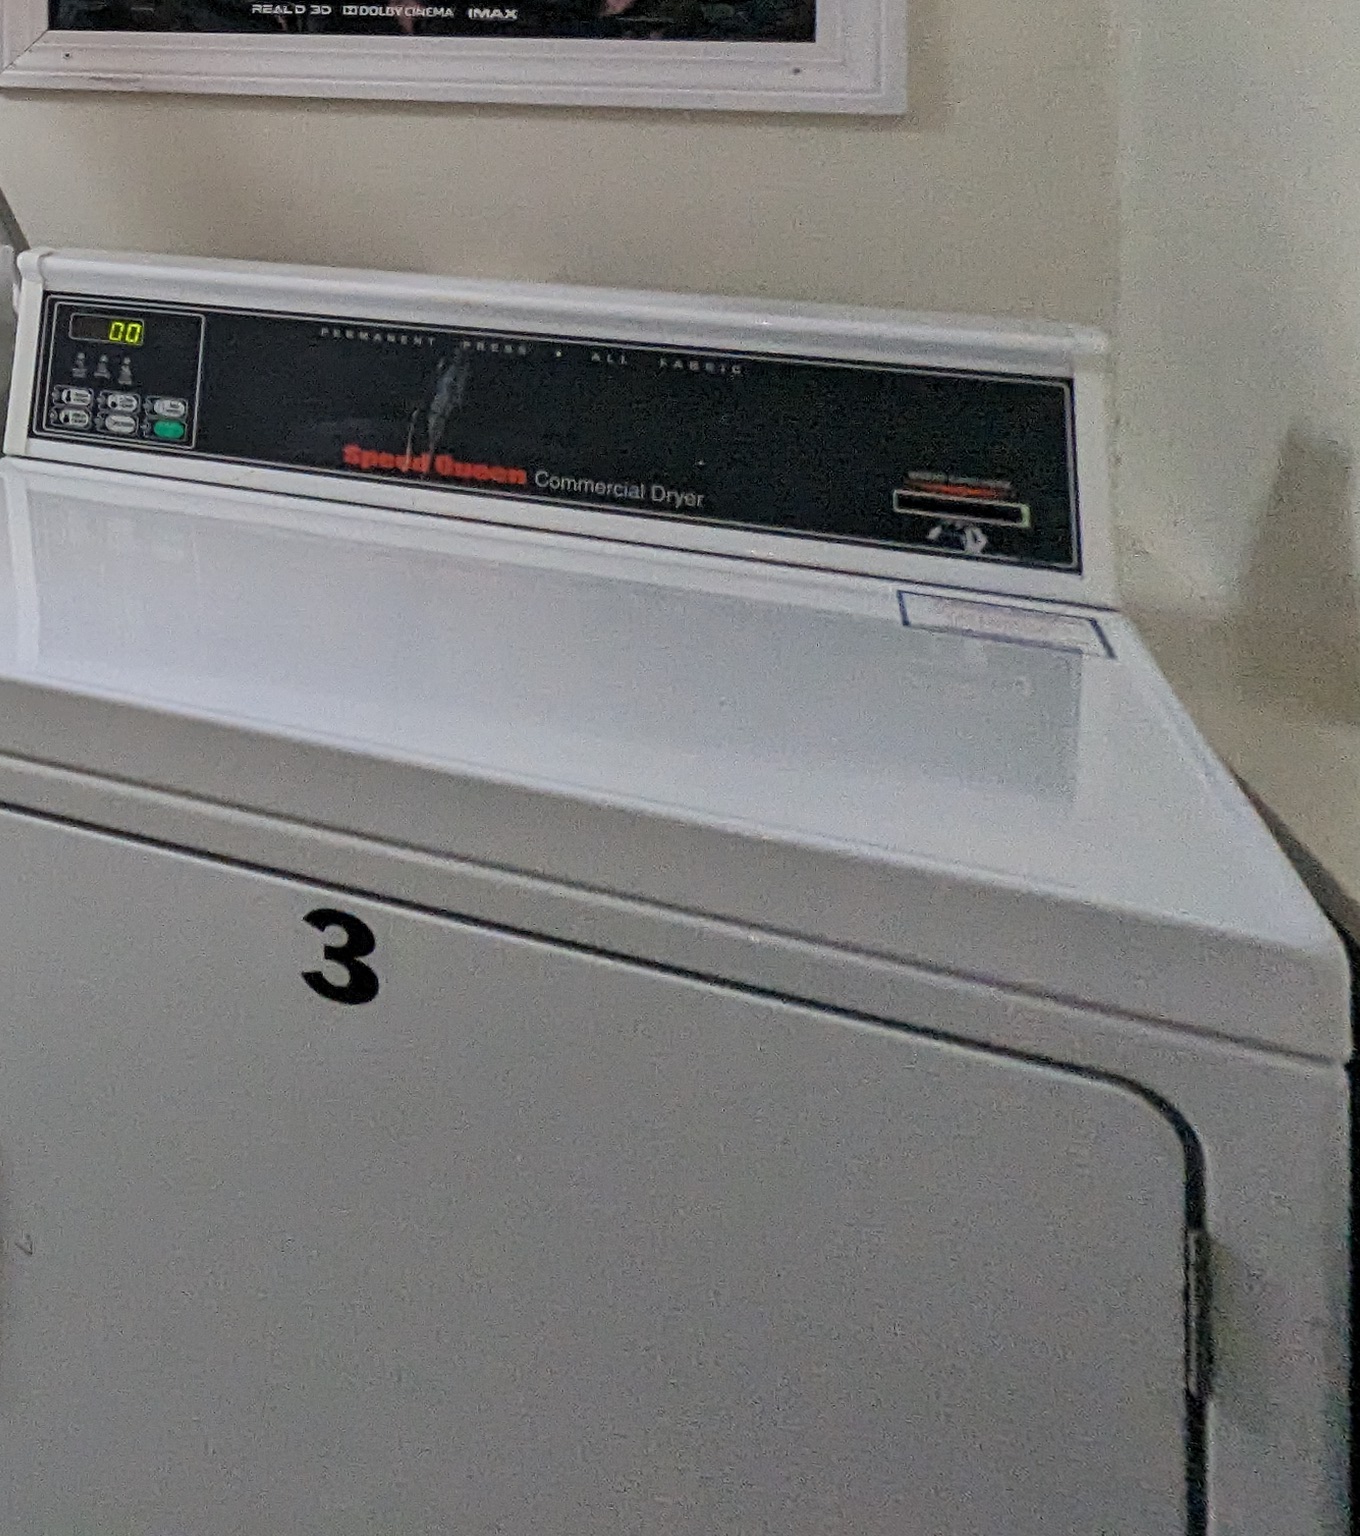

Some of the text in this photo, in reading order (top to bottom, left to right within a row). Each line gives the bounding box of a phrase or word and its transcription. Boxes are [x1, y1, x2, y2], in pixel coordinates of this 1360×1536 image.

[310, 4, 332, 15] 3D
[359, 5, 455, 18] DOLBY CINEMA
[467, 8, 519, 20] IMAX
[108, 321, 143, 344] 00
[591, 352, 628, 365] ALL
[534, 470, 705, 509] Commercial Dryer
[301, 908, 379, 1005] 3
